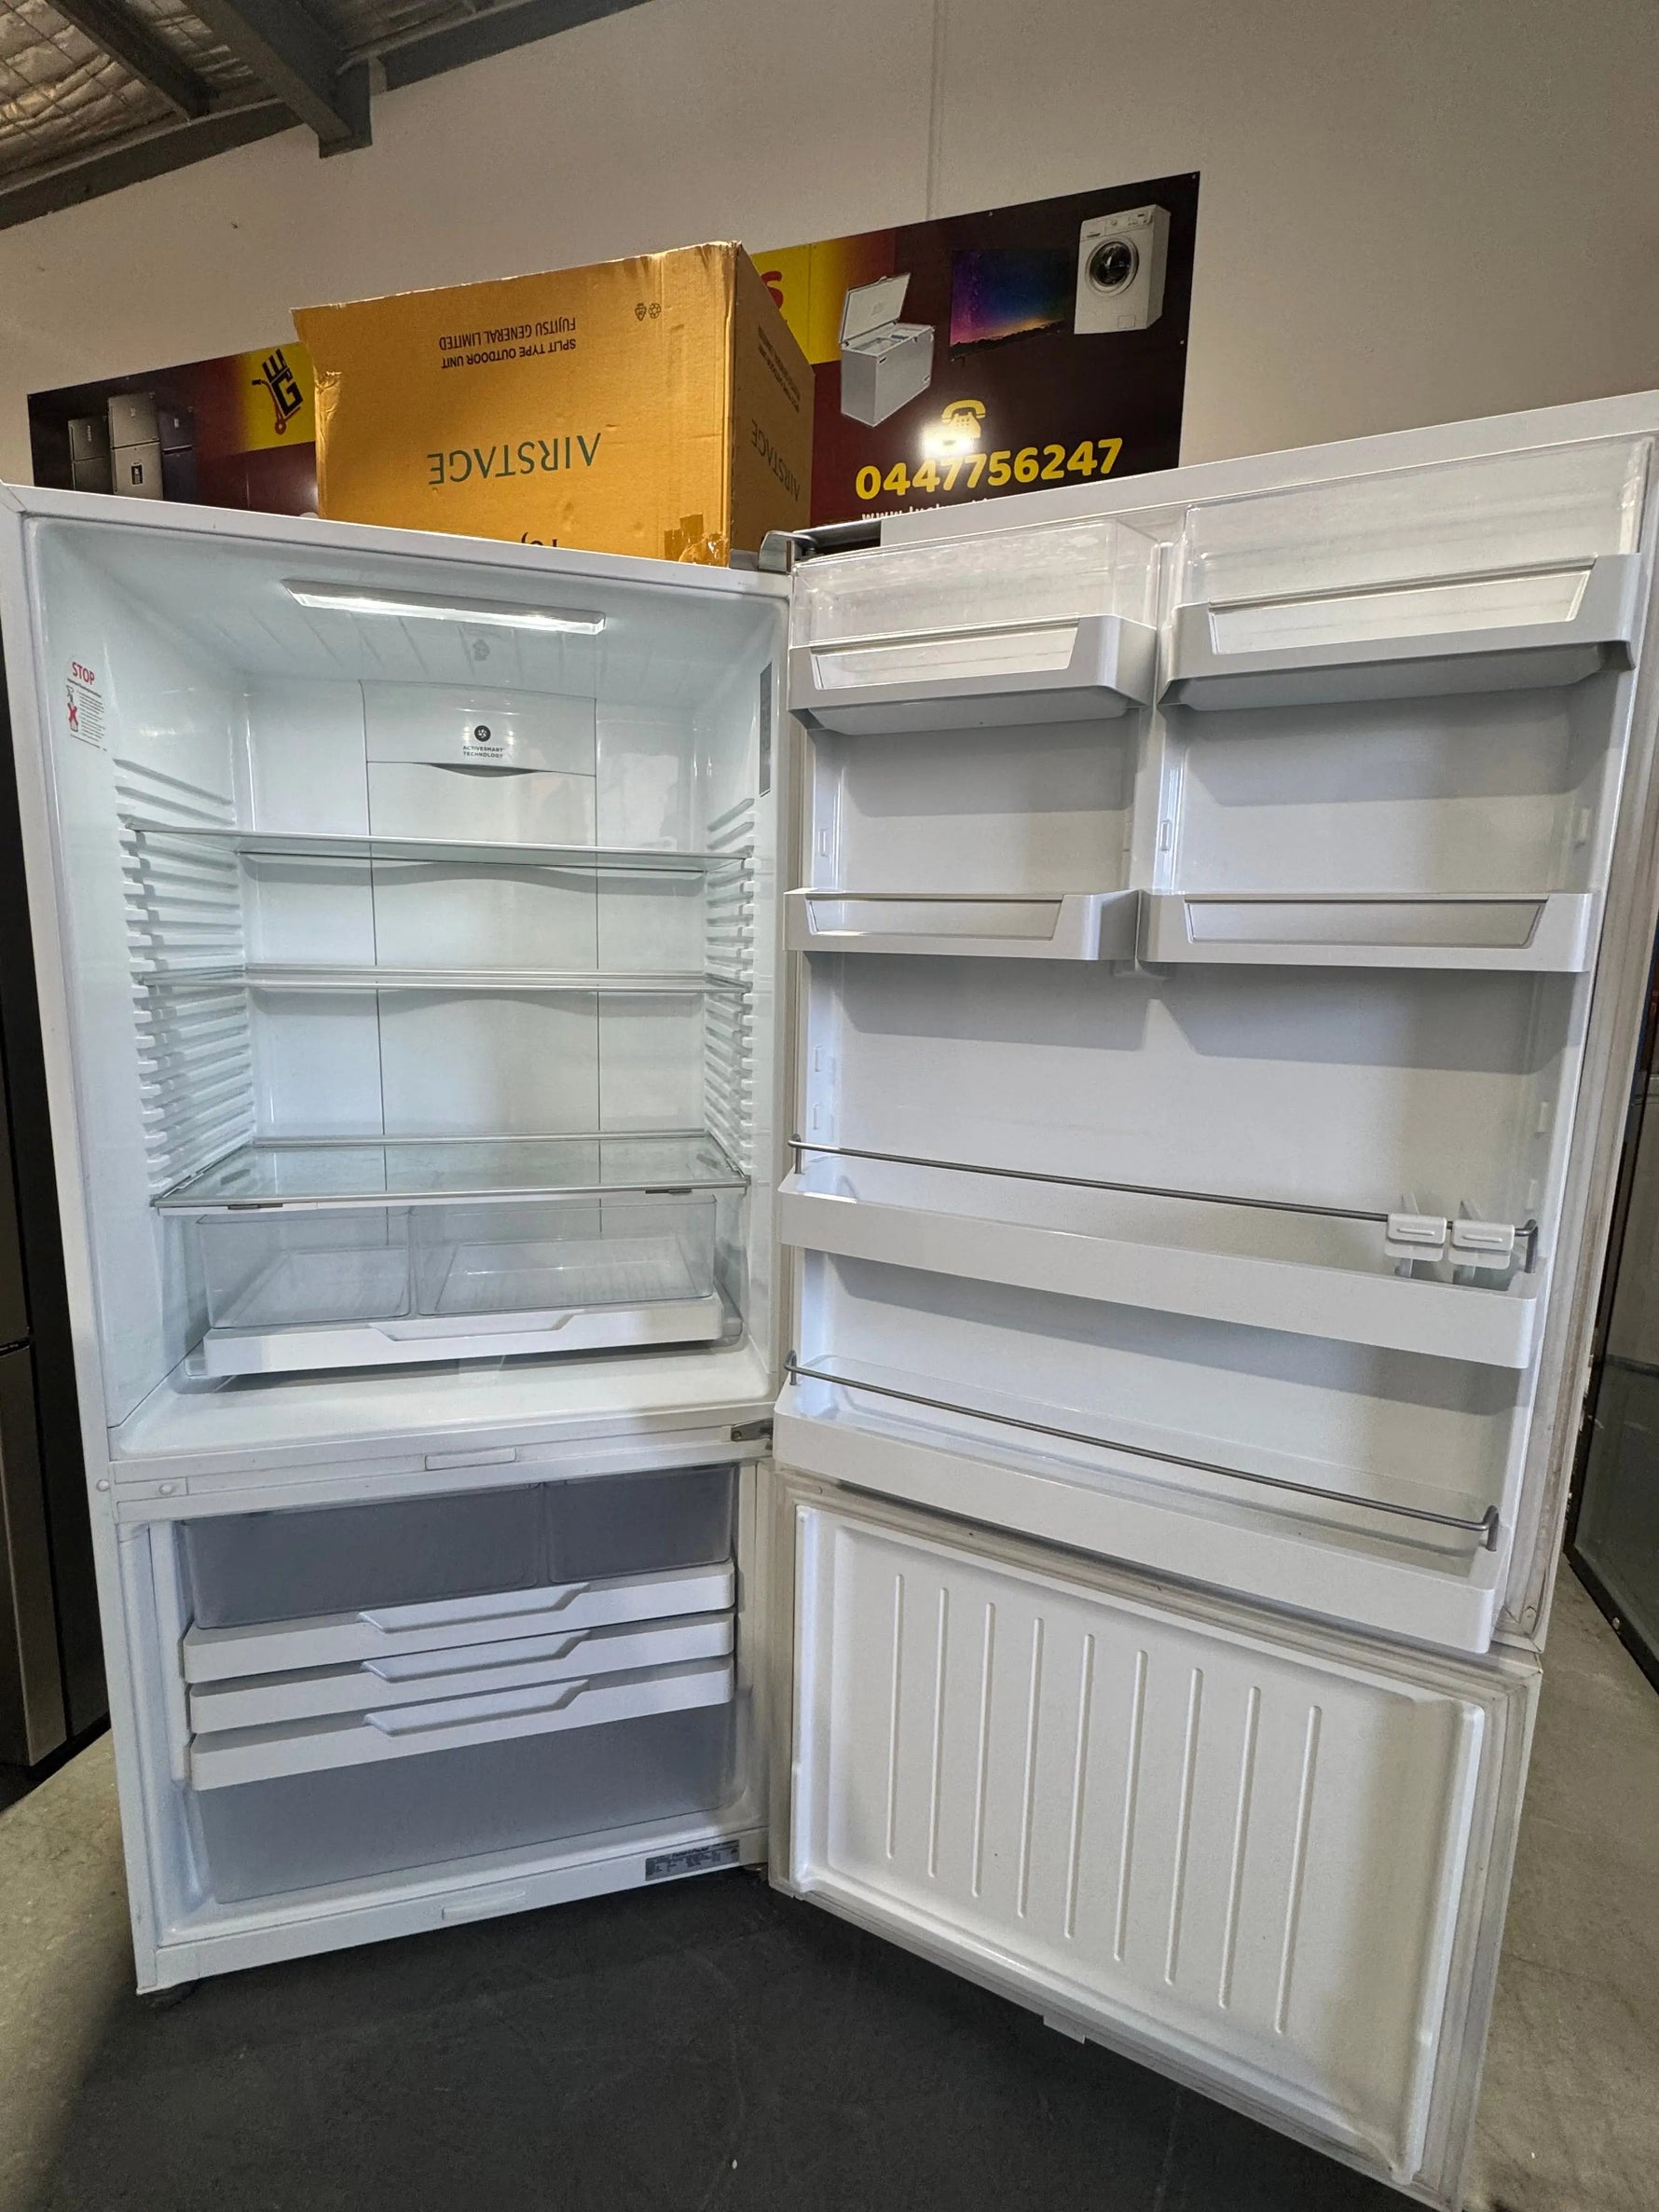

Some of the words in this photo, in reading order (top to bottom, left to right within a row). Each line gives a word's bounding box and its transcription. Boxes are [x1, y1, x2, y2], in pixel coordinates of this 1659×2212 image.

[483, 324, 532, 344] GENERAL
[535, 317, 576, 337] FUJITSU
[439, 332, 482, 350] LIMITED
[519, 343, 545, 358] TYPE
[547, 338, 576, 353] SPLIT
[442, 355, 464, 369] UNIT
[466, 348, 516, 365] OUTDOOR
[426, 433, 602, 485] AIRSTAGE
[856, 437, 1123, 500] 0447756247
[72, 661, 95, 685] STOP
